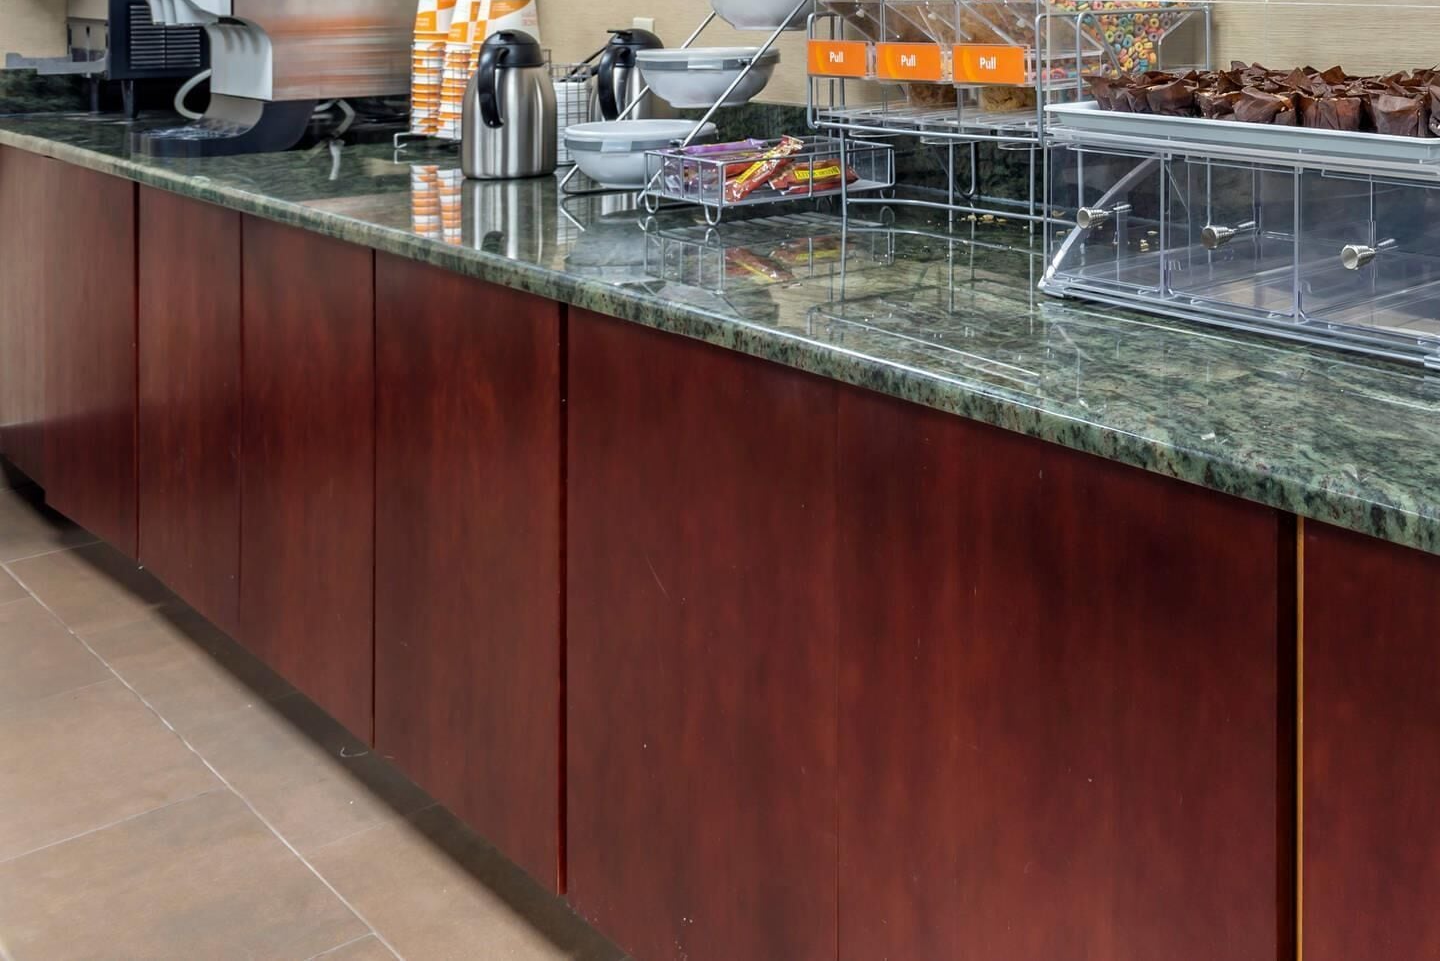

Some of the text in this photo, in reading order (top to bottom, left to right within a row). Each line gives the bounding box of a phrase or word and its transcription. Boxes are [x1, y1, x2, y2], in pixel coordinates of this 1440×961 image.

[829, 51, 844, 63] Pull
[901, 54, 916, 67] Pull
[979, 56, 997, 70] Pull
